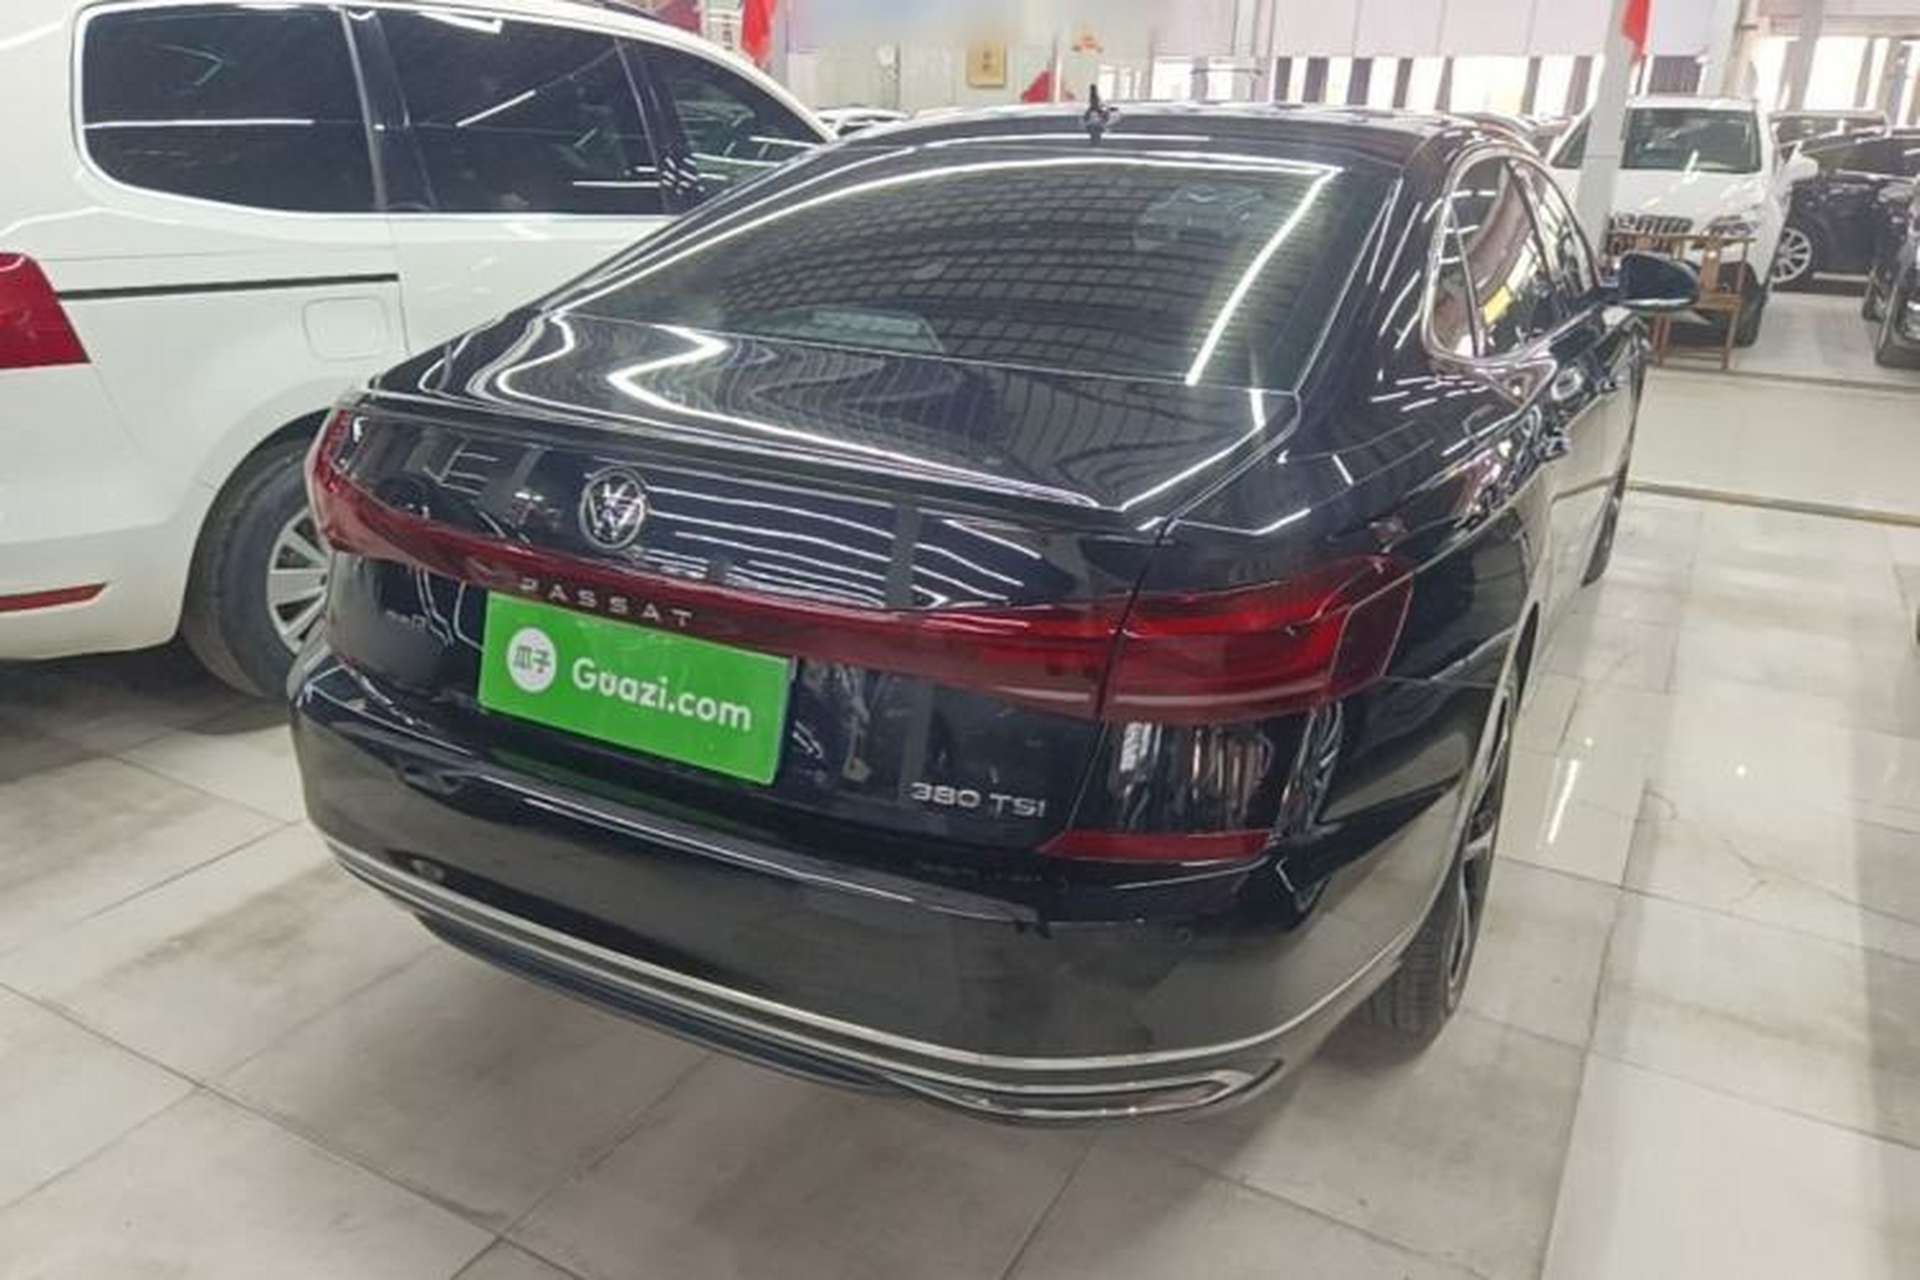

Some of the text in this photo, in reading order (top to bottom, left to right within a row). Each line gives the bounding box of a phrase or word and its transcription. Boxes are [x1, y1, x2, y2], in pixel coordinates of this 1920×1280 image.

[512, 643, 552, 675] 瓜子
[571, 656, 753, 732] Guazi.com
[910, 781, 1047, 818] 380 TSI
